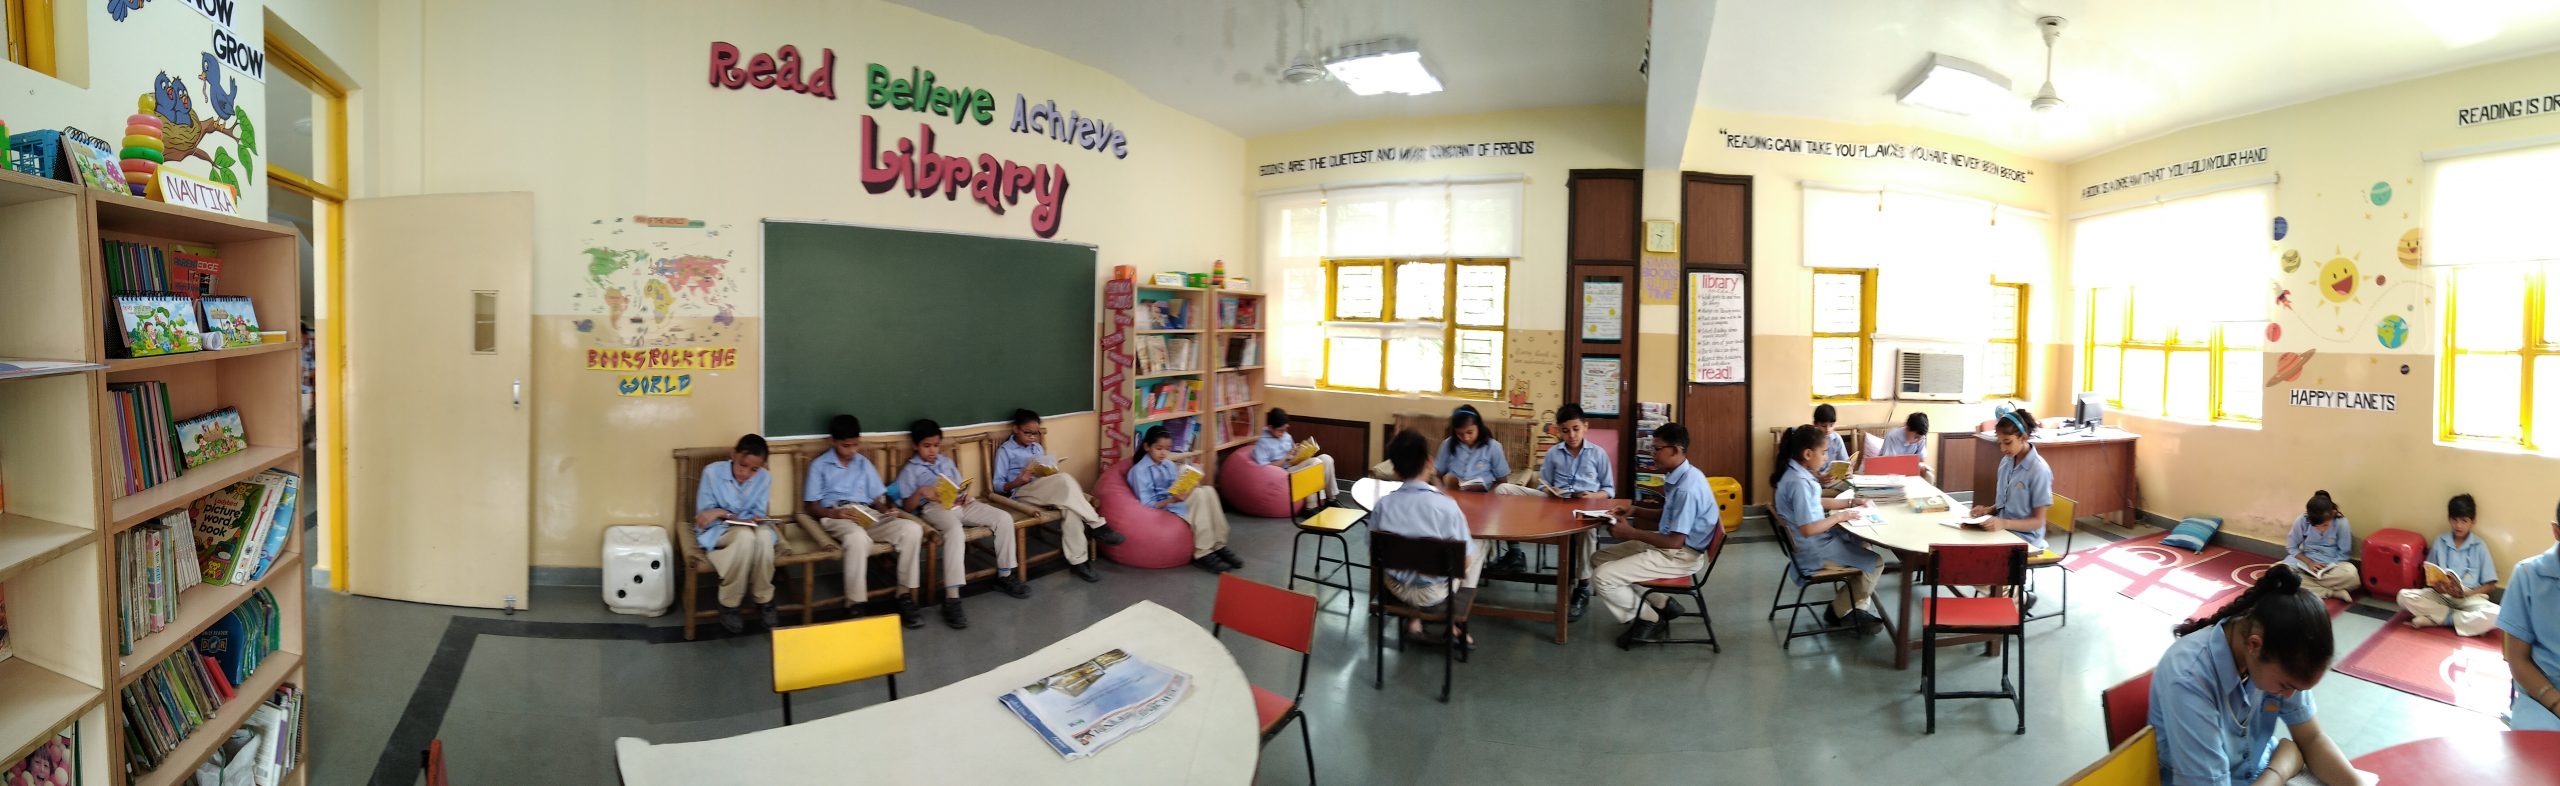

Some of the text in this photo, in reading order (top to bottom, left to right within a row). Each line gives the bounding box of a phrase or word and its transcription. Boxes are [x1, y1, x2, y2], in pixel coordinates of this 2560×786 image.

[213, 29, 264, 79] GROW
[708, 41, 1129, 160] Read Believe Achieve
[2459, 100, 2522, 126] READING
[2526, 97, 2539, 115] IS
[1288, 160, 1306, 173] ARE
[1309, 156, 1327, 171] THE
[1330, 150, 1374, 167] QUIETEST
[1478, 143, 1491, 157] OF
[1493, 141, 1535, 156] FRIENDS
[1834, 143, 1857, 157] YOU
[2239, 147, 2267, 165] HAND
[859, 114, 1070, 239] Library
[1702, 274, 1739, 291] library
[587, 348, 737, 369] BOOKS ROCK THE
[1701, 367, 1733, 380] read!
[619, 374, 691, 394] WORLD
[2290, 389, 2395, 411] HAPPY PLANETS
[203, 504, 241, 518] picture
[204, 514, 232, 526] word
[199, 522, 227, 537] book
